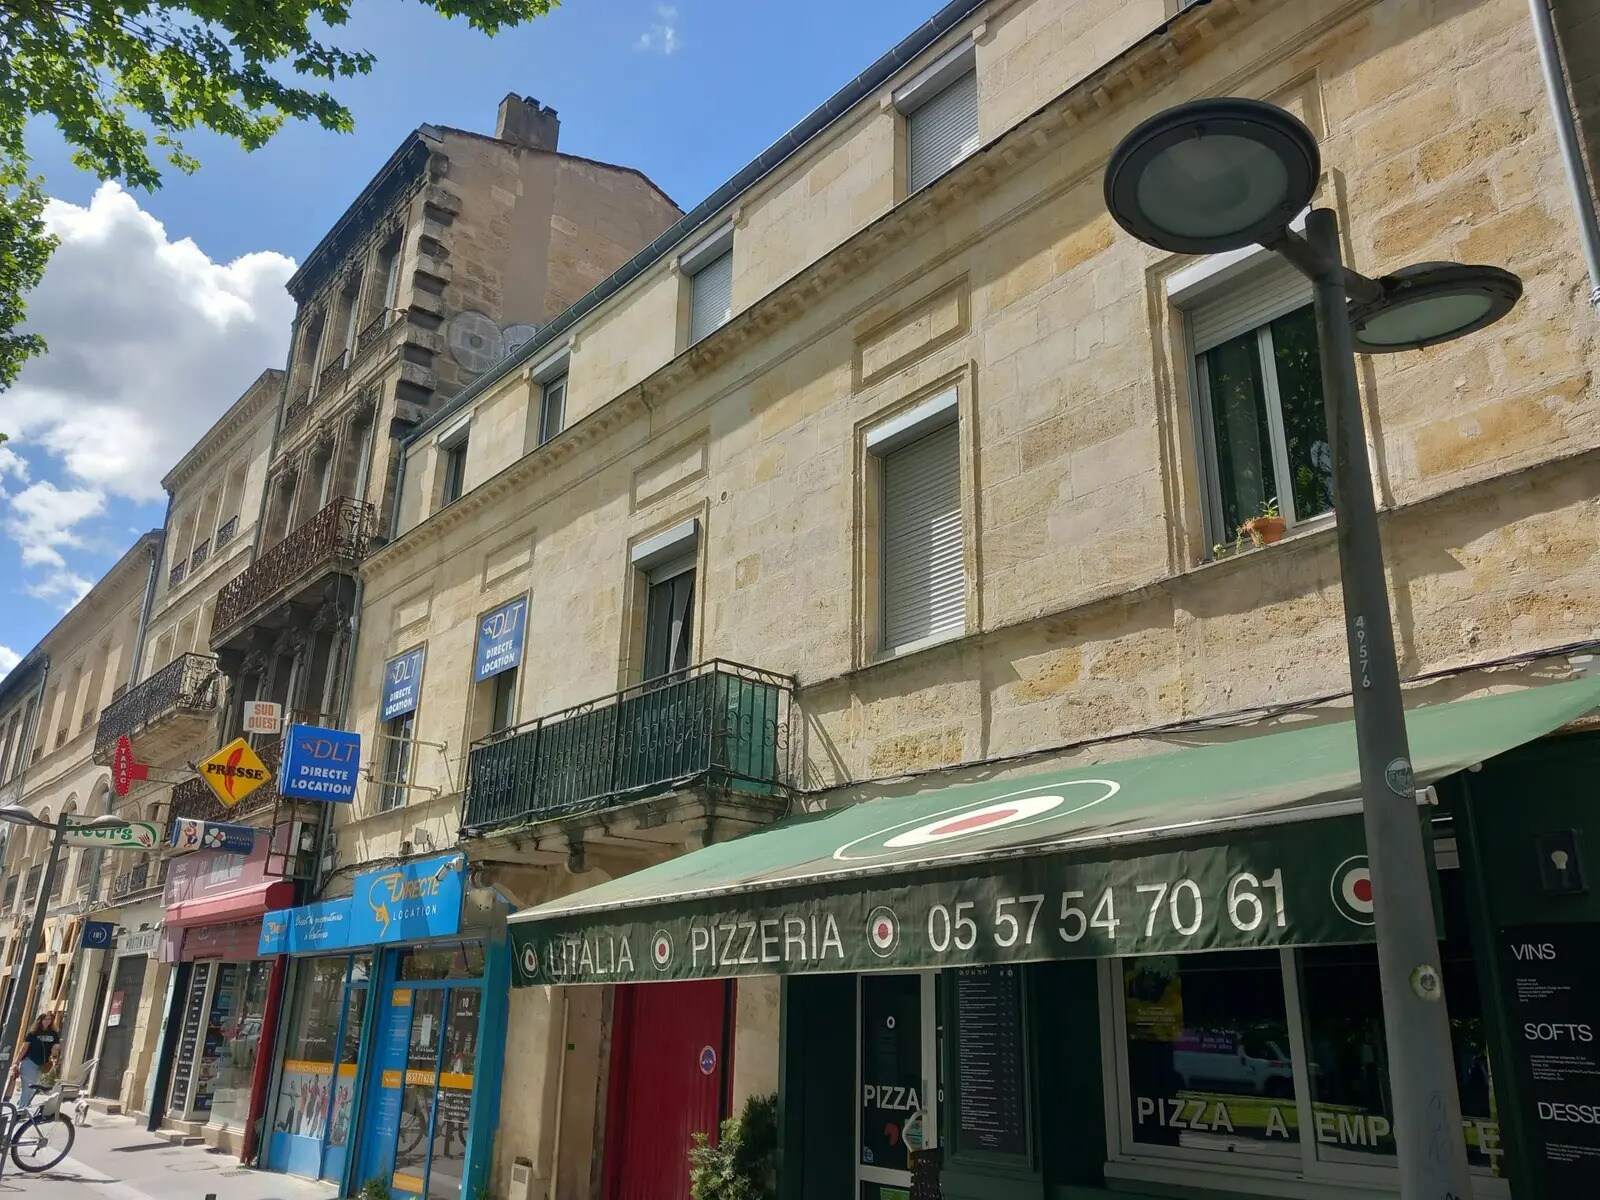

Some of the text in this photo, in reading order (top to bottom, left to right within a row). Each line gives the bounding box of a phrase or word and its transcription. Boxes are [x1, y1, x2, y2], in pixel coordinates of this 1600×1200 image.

[490, 603, 523, 639] DLT
[486, 639, 514, 660] DIRECTE
[1355, 615, 1371, 688] 49576
[394, 653, 421, 685] DLT
[481, 653, 515, 675] LOCATION
[389, 685, 412, 703] DIRECTE
[254, 703, 274, 716] SUD
[385, 697, 413, 716] LOCATION
[248, 716, 277, 730] OUEST
[314, 740, 359, 762] DLT
[206, 763, 264, 780] PRESSE
[300, 765, 348, 780] DIRECTE
[290, 778, 352, 795] LOCATION
[392, 905, 437, 920] LOCATION
[928, 868, 1286, 952] 05 57 54 70 61
[692, 914, 844, 967] PIZZERIA
[1511, 943, 1556, 960] VINS
[1524, 1022, 1593, 1042] SOFTS
[864, 1084, 920, 1112] PIZZA
[1137, 1096, 1234, 1133] PIZZA
[1265, 1106, 1290, 1138] A
[1538, 1102, 1600, 1124] DESSE
